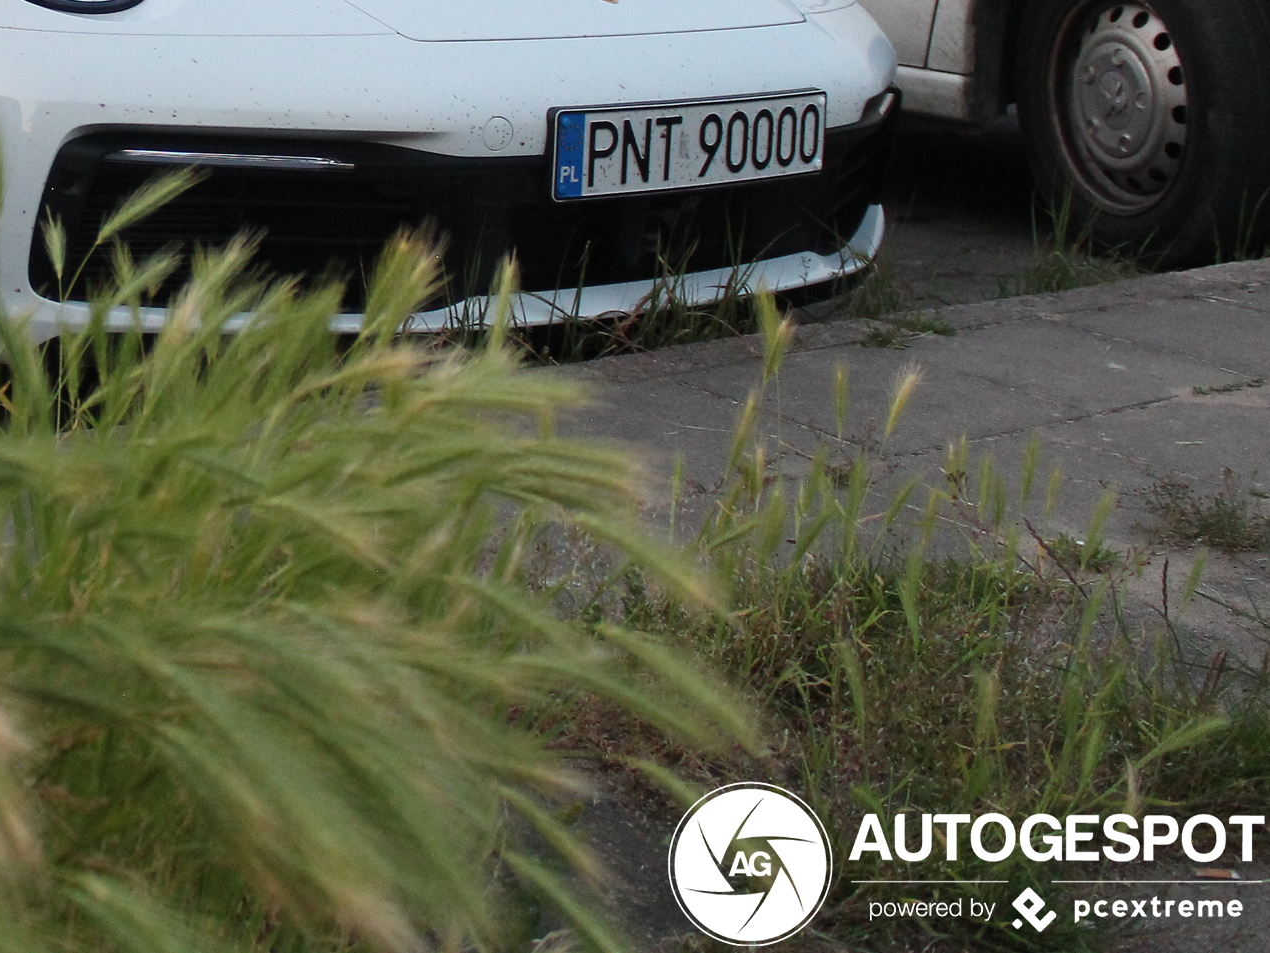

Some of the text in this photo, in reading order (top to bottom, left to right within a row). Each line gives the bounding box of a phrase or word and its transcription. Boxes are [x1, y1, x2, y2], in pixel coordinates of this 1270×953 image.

[588, 104, 820, 187] PNT 90000
[560, 165, 579, 183] PL
